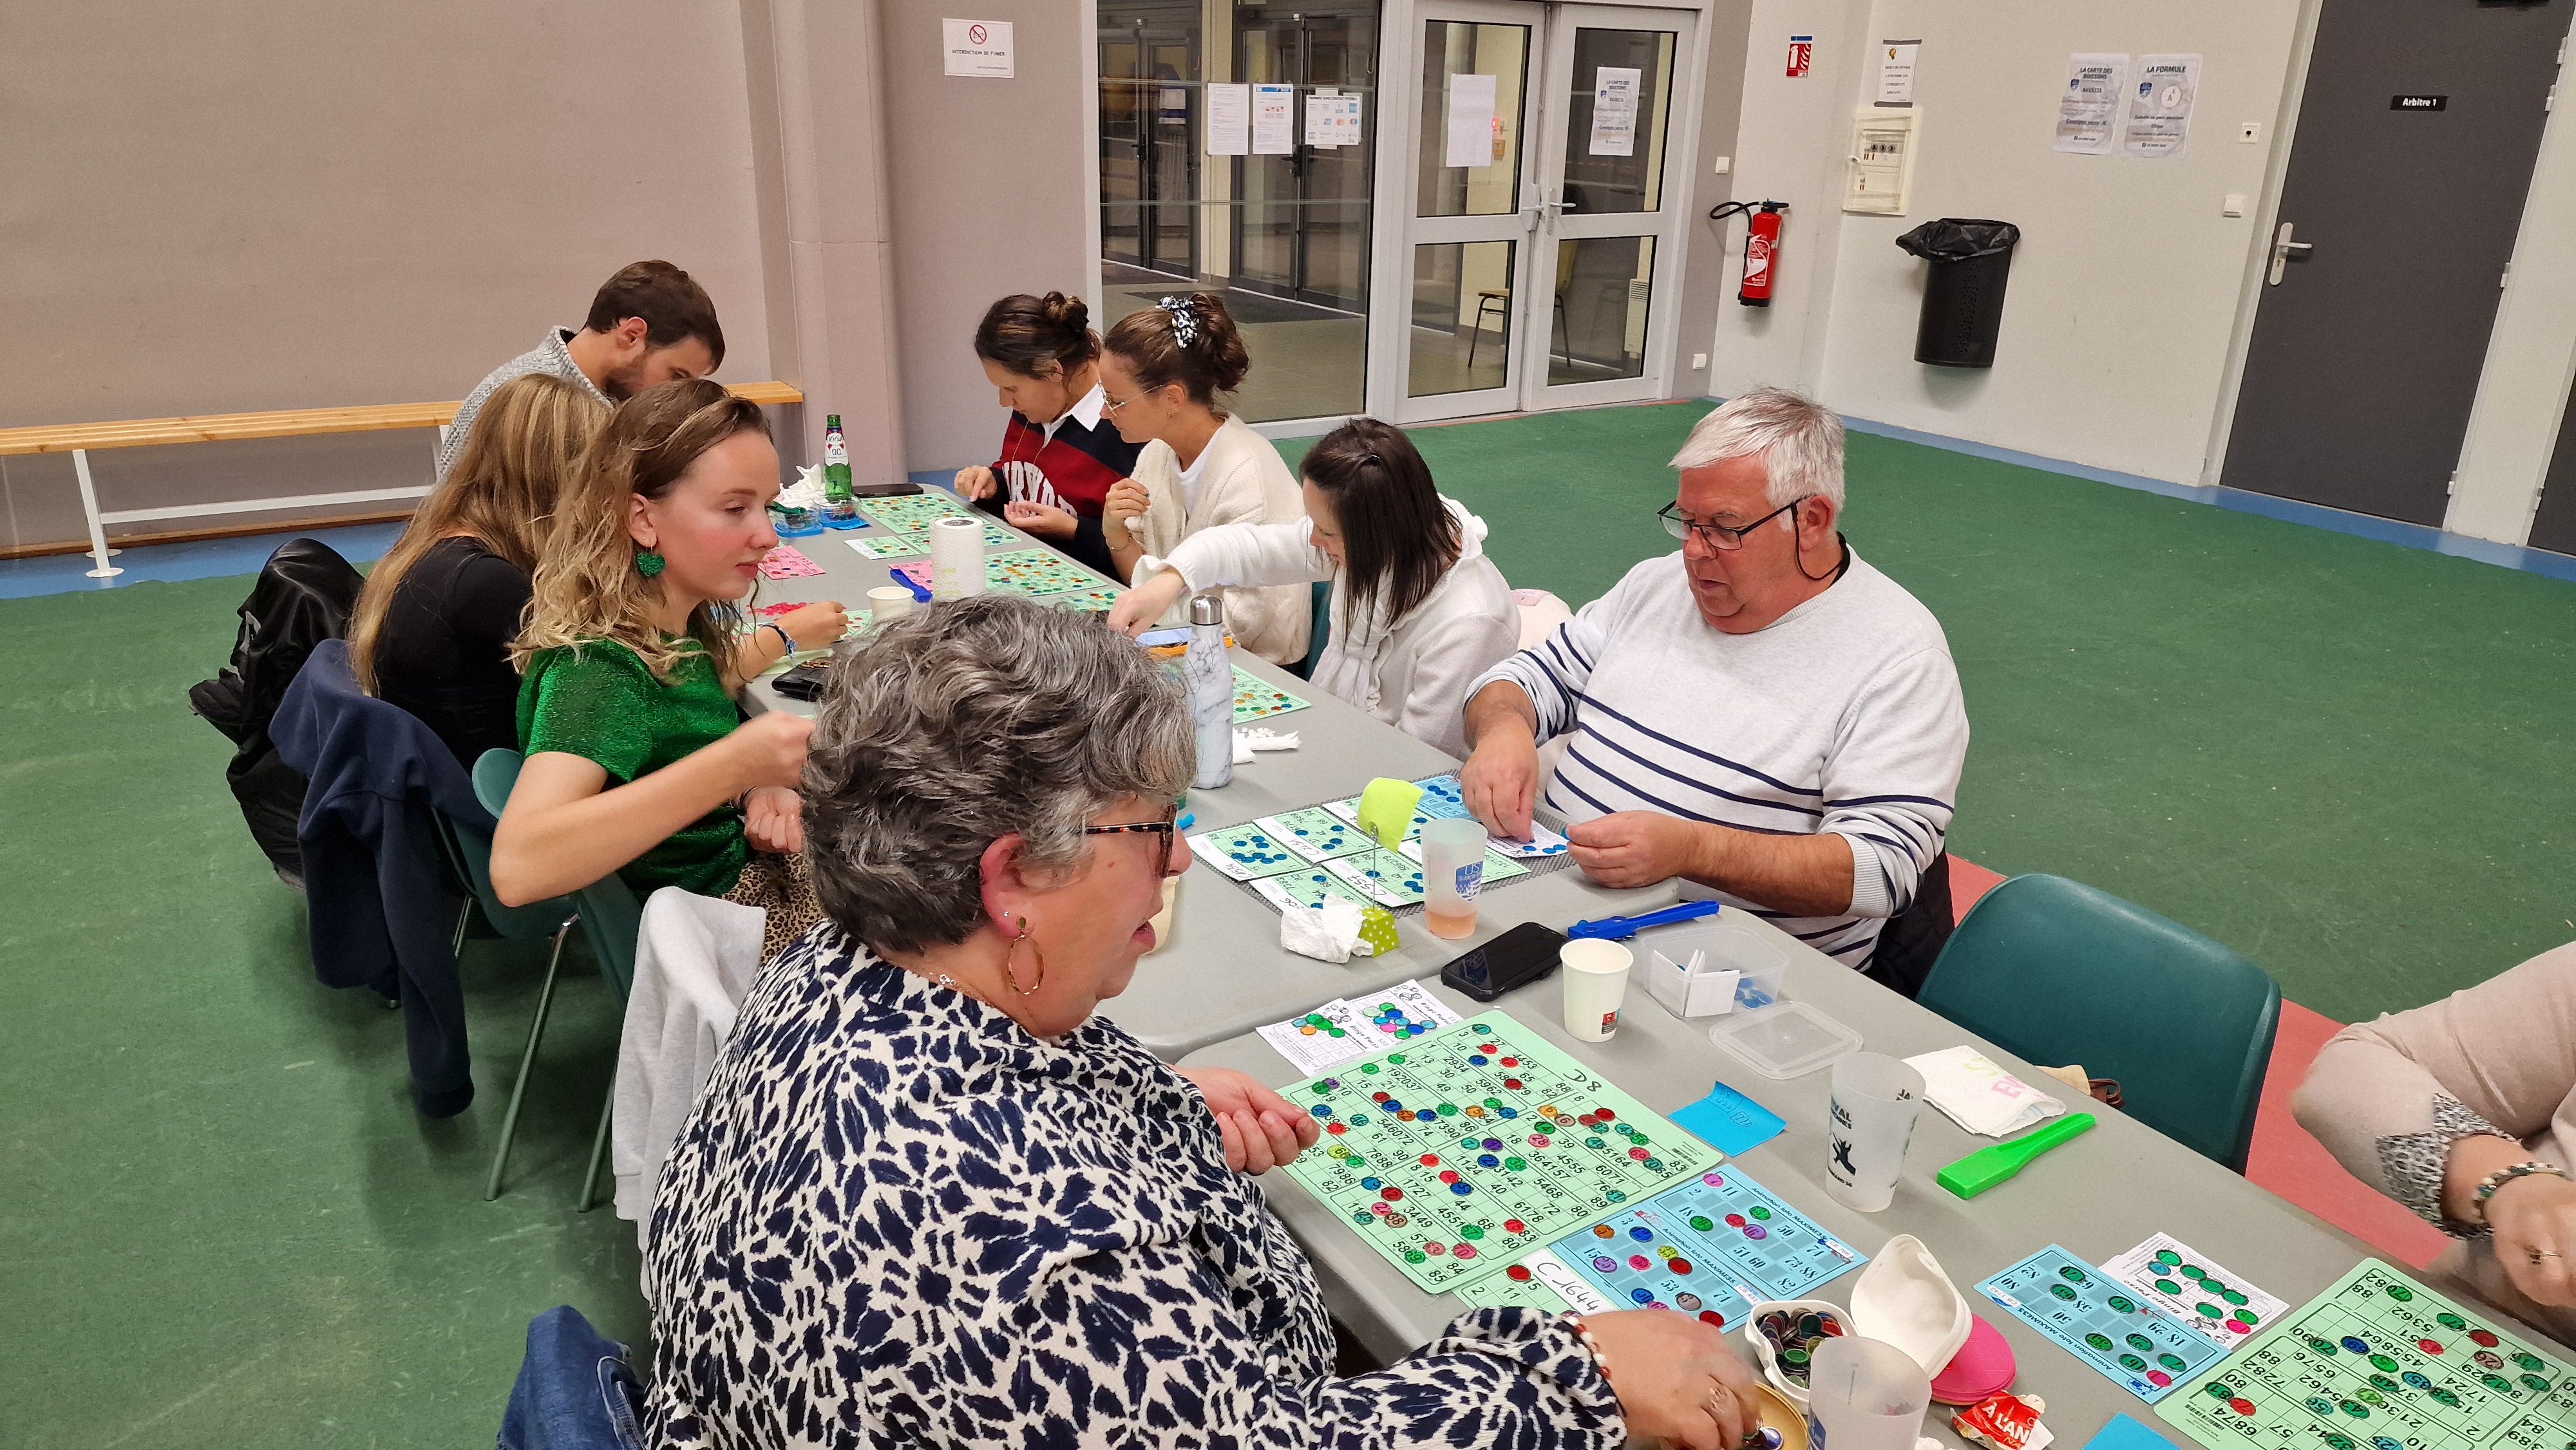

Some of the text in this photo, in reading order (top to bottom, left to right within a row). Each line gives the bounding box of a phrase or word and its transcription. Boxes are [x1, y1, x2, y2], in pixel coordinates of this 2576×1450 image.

[2402, 98, 2430, 106] Arbitre
[1465, 863, 1481, 875] US
[1421, 1003, 1437, 1014] Bingo
[1350, 1025, 1365, 1037] Bingo
[1453, 1042, 1467, 1051] 10
[1421, 1055, 1435, 1064] 13
[1522, 1059, 1538, 1069] 53
[1387, 1068, 1400, 1077] 19
[1519, 1073, 1536, 1082] 65
[1357, 1079, 1372, 1089] 15
[1406, 1081, 1422, 1091] 37
[1461, 1084, 1477, 1094] 50
[1337, 1086, 1352, 1096] 10
[1377, 1119, 1390, 1129] 54
[1388, 1125, 1403, 1137] 60
[1445, 1126, 1461, 1138] 90
[1506, 1135, 1522, 1144] 18
[1309, 1147, 1325, 1157] 53
[1392, 1150, 1409, 1160] 90
[1557, 1154, 1573, 1165] 45
[1615, 1156, 1633, 1168] 64
[1595, 1165, 1613, 1176] 60
[1669, 1161, 1687, 1172] 83
[1420, 1171, 1436, 1182] 15
[1609, 1174, 1626, 1185] 71
[1403, 1179, 1419, 1189] 17
[1593, 1180, 1611, 1192] 76
[1722, 1187, 1738, 1197] 11
[1513, 1201, 1531, 1213] 61
[1751, 1187, 1781, 1209] Animation
[1780, 1207, 1793, 1217] loto
[1438, 1207, 1452, 1219] 45
[1571, 1205, 1588, 1217] 80
[1449, 1216, 1466, 1228] 51
[1410, 1233, 1428, 1244] 57
[1663, 1228, 1736, 1284] Animation loto MAXIME35
[1733, 1247, 1751, 1259] 51
[1748, 1257, 1766, 1270] 60
[1429, 1270, 1448, 1282] 85
[2365, 1273, 2387, 1288] 82
[1660, 1279, 1680, 1292] 53
[2352, 1285, 2373, 1298] 88
[2123, 1280, 2182, 1315] Bingo Perso
[2391, 1306, 2412, 1321] 62
[2412, 1318, 2434, 1332] 53
[2017, 1308, 2114, 1371] Animation loto MAXIME35
[2360, 1330, 2382, 1344] 64
[2382, 1342, 2403, 1355] 58
[2259, 1350, 2281, 1365] 88
[2293, 1352, 2315, 1367] 76
[2401, 1353, 2424, 1367] 45
[2244, 1361, 2266, 1376] 82
[2313, 1364, 2336, 1379] 65
[2461, 1364, 2485, 1377] 29
[2225, 1373, 2247, 1389] 80
[2264, 1373, 2287, 1388] 72
[2298, 1375, 2322, 1389] 62
[2445, 1377, 2468, 1391] 24
[2320, 1388, 2343, 1402] 54
[2465, 1390, 2487, 1403] 17
[2510, 1389, 2523, 1399] 8
[2550, 1393, 2574, 1408] 83
[2213, 1408, 2235, 1424] 74
[2400, 1414, 2423, 1428] 21
[2234, 1420, 2257, 1436] 68
[2269, 1424, 2294, 1439] 57
[2467, 1426, 2481, 1436] 2
[2521, 1418, 2544, 1434] 84
[2508, 1431, 2532, 1445] 89
